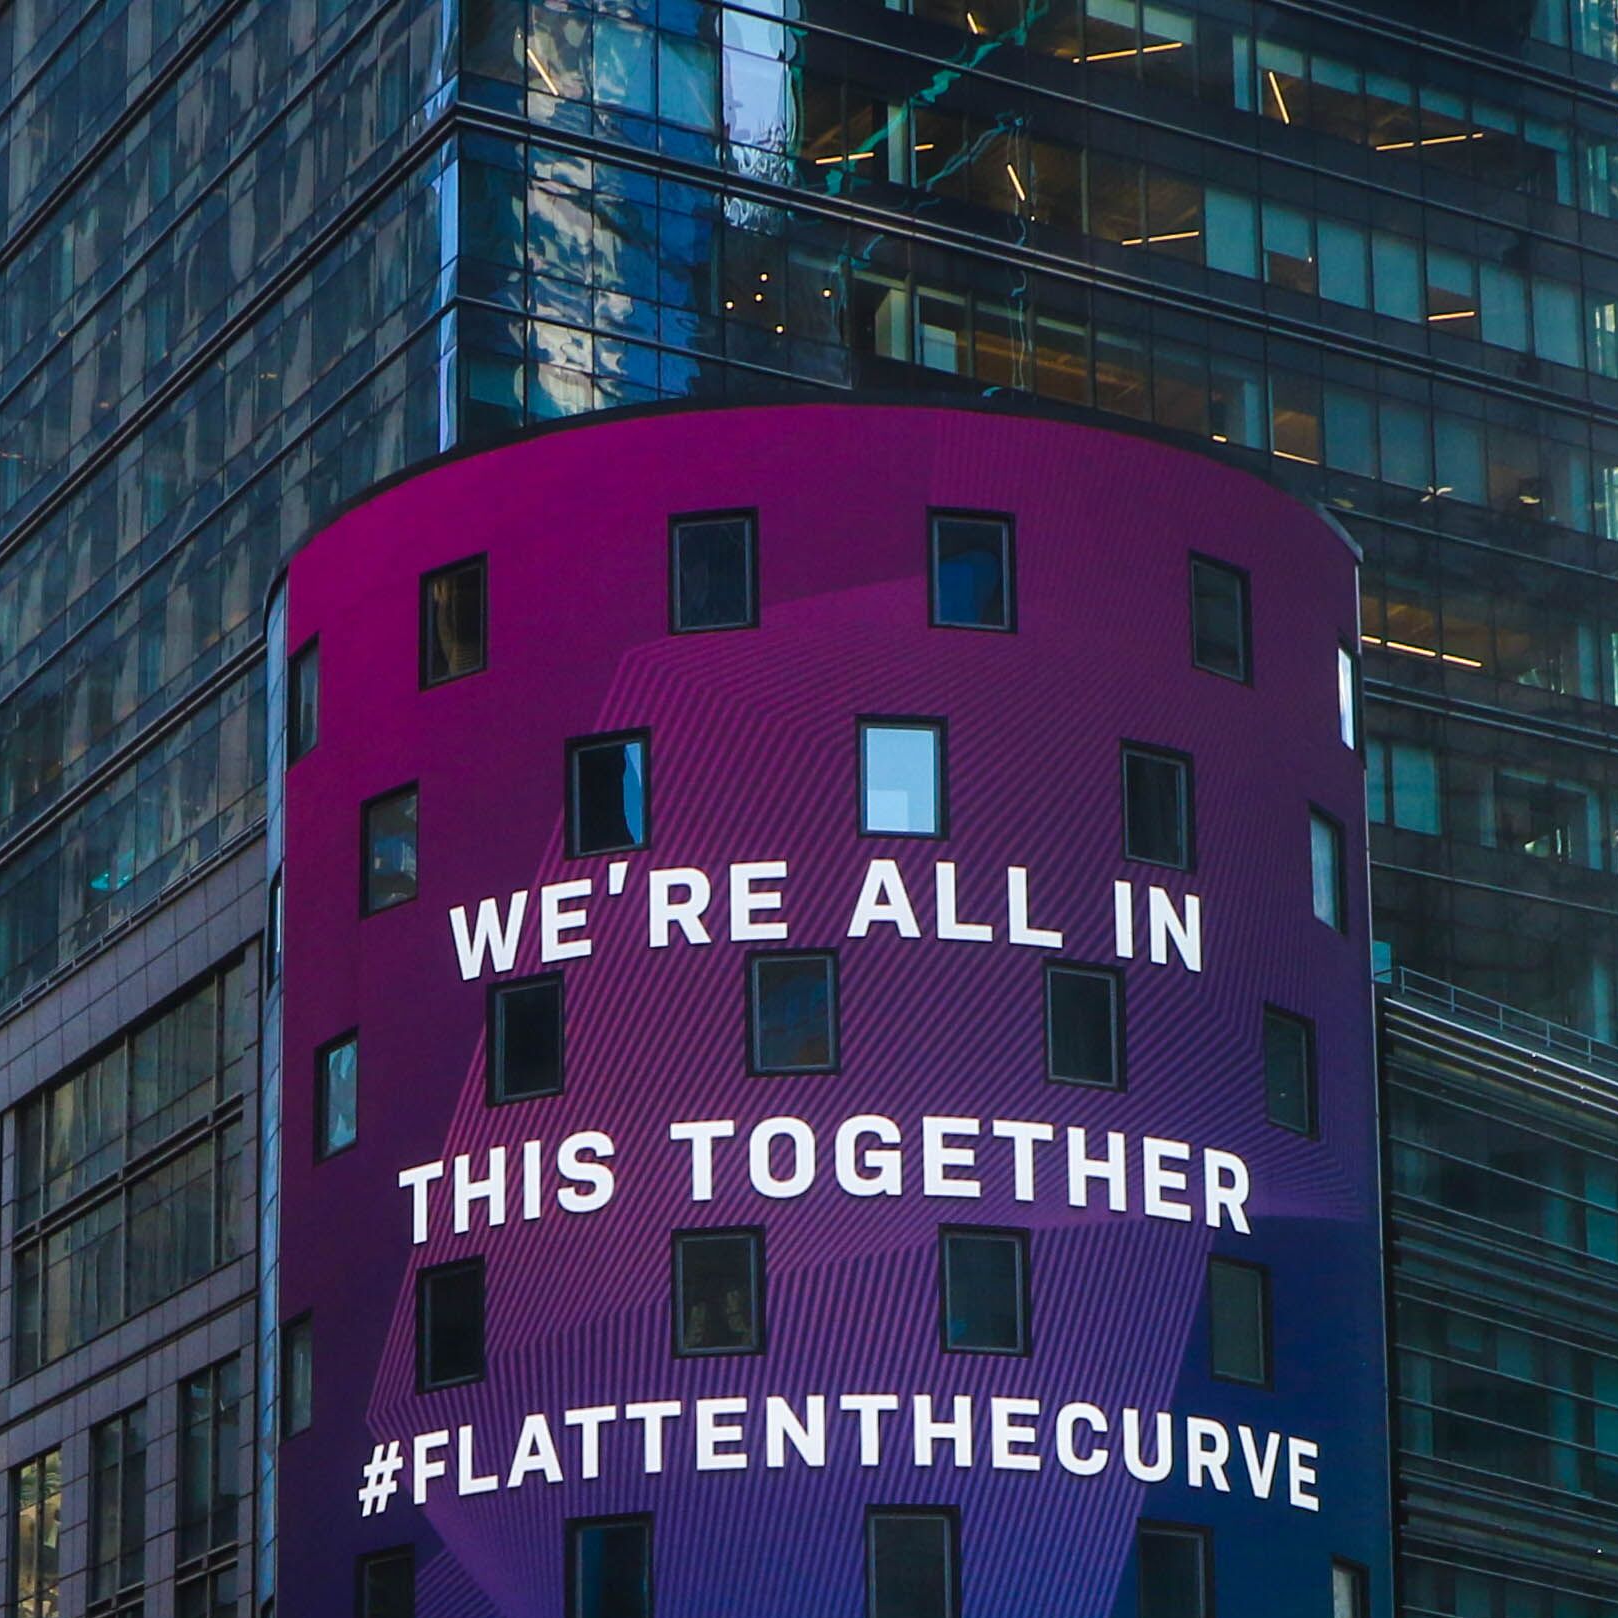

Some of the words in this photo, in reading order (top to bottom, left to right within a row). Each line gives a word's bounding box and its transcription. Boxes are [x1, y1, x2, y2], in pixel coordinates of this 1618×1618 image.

[450, 862, 788, 981] WE'RE
[847, 859, 1063, 948] ALL
[1114, 880, 1201, 972] IN
[398, 1131, 615, 1244] THIS
[670, 1114, 1251, 1234] TOGETHER
[359, 1395, 1319, 1517] #FLATTENTHECURVE
